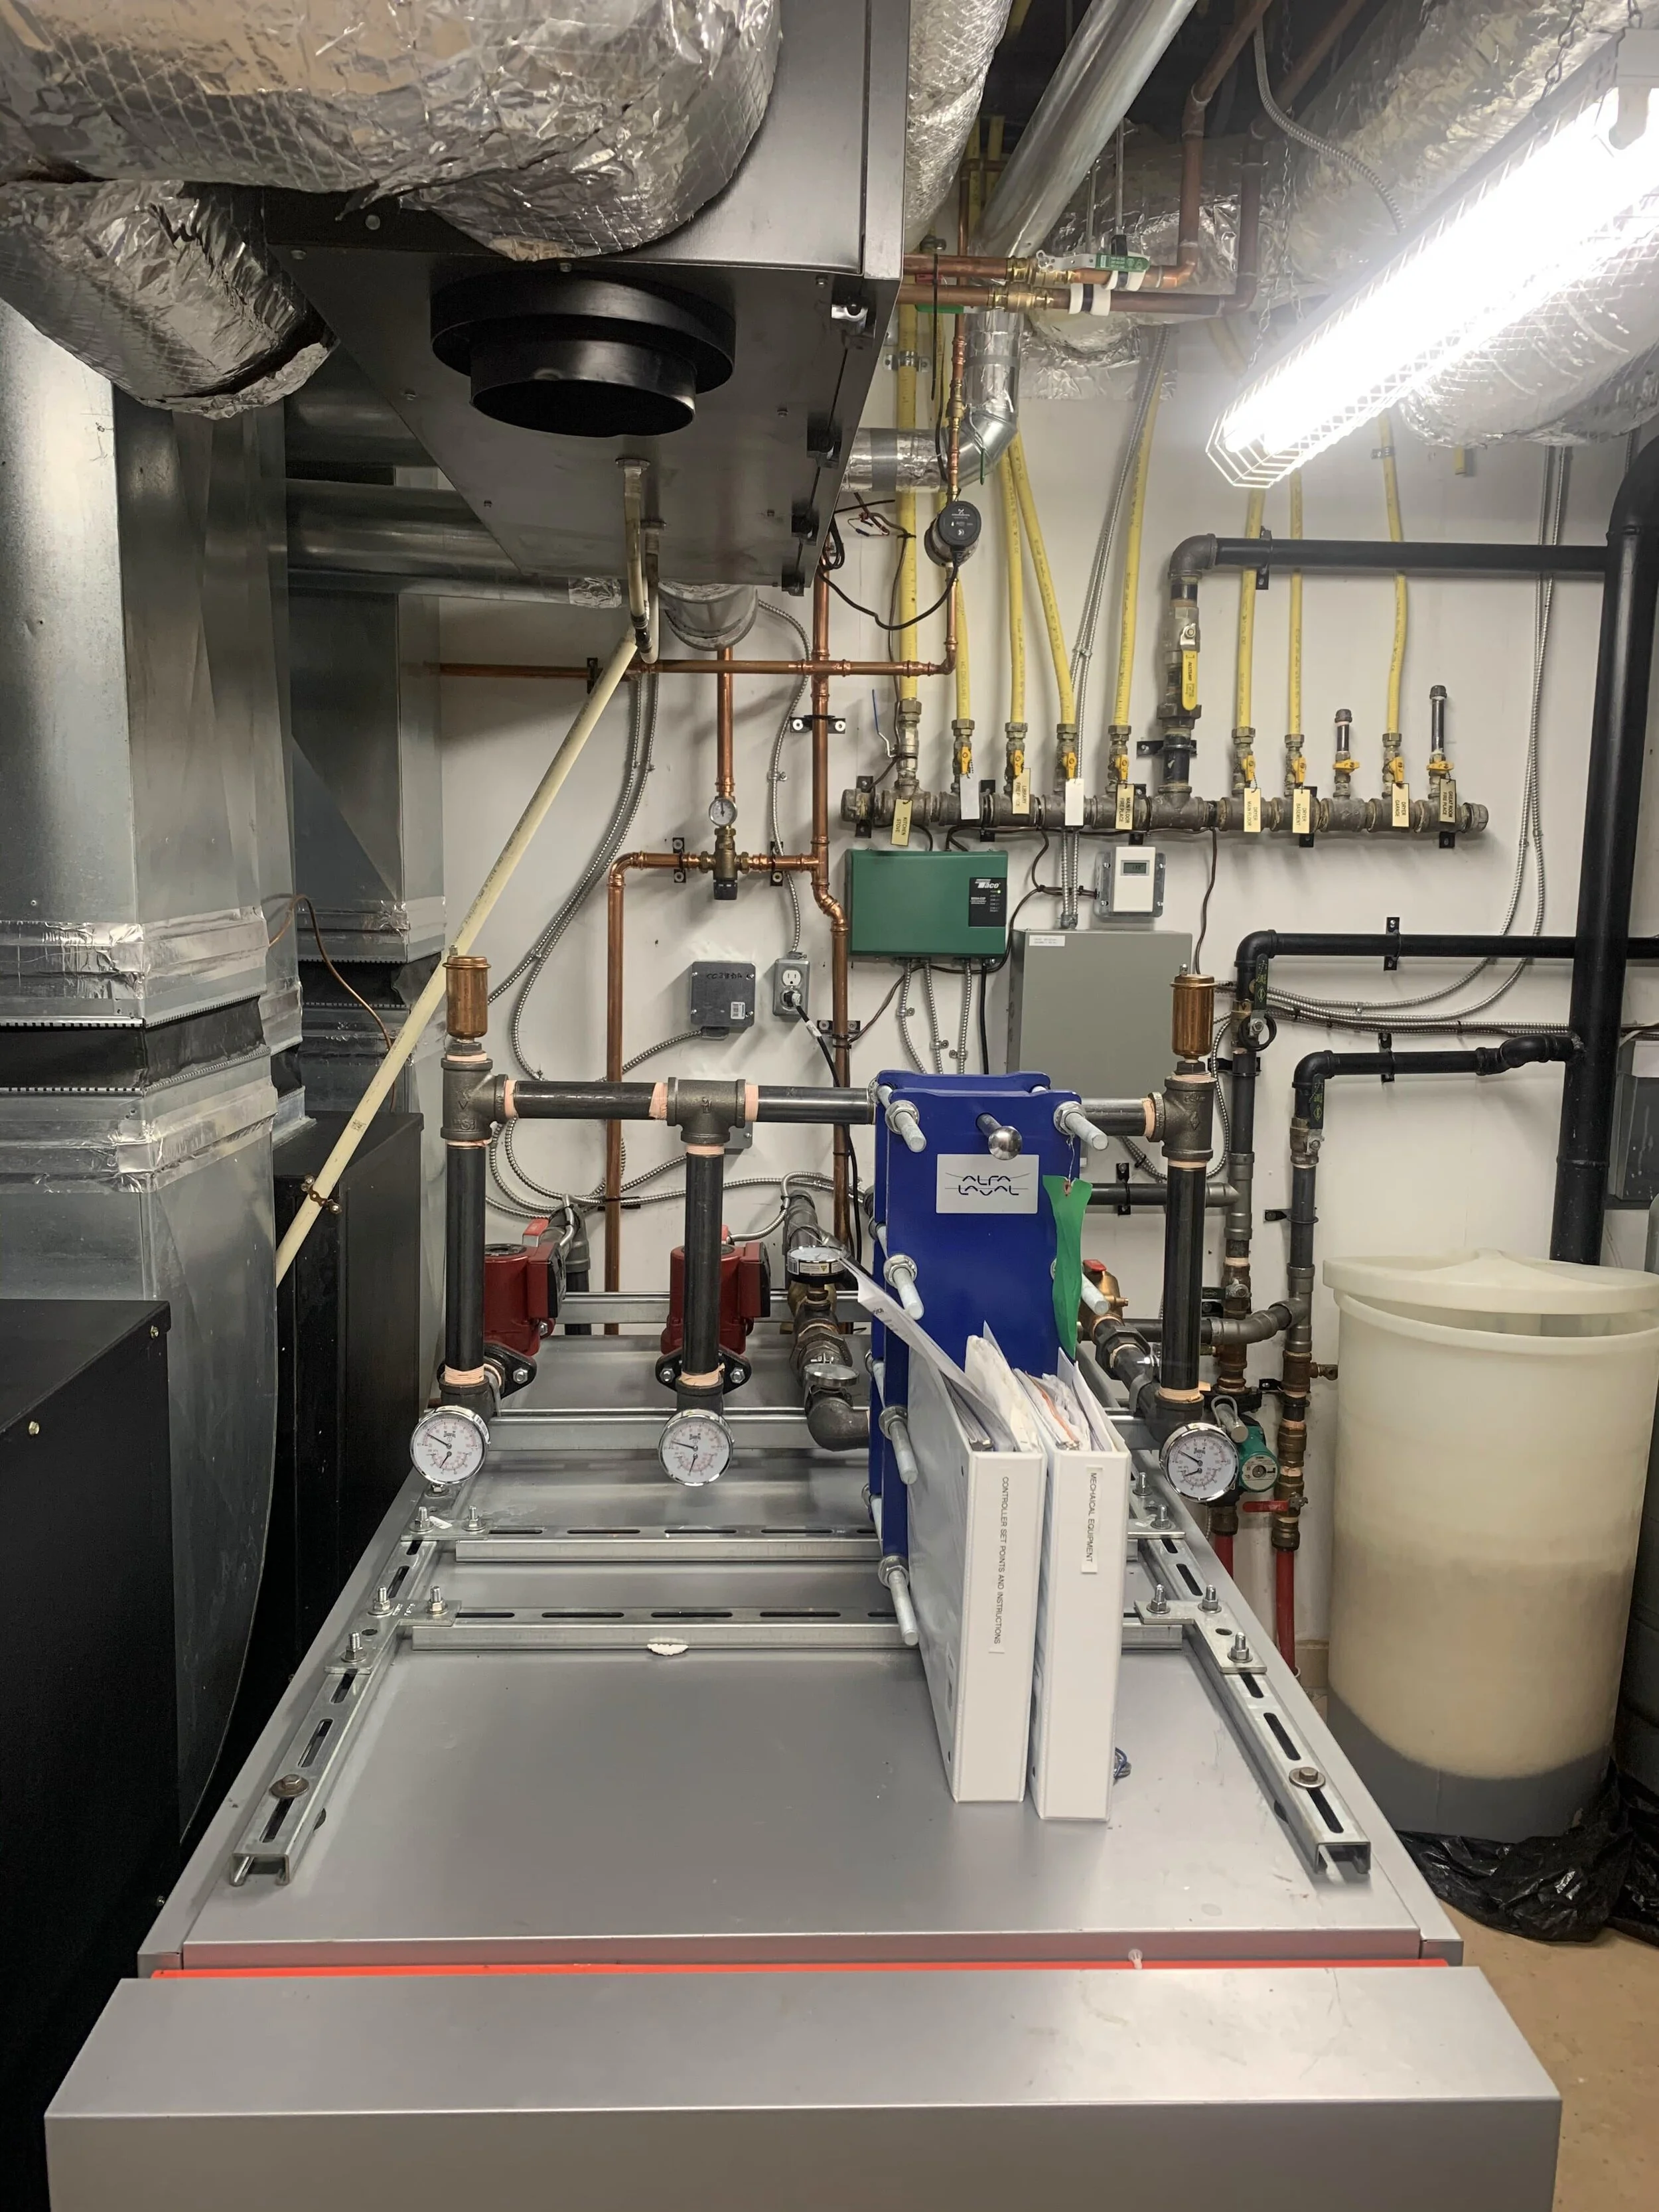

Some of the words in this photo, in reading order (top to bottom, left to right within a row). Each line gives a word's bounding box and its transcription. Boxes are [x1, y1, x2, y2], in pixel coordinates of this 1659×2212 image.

[958, 1185, 1019, 1196] LAVAL
[962, 1175, 1011, 1185] ALFA
[1088, 1472, 1097, 1516] MECHAICAL
[1086, 1518, 1095, 1563] EQUIPMENT
[994, 1591, 1003, 1644] INSTRUCTIONS
